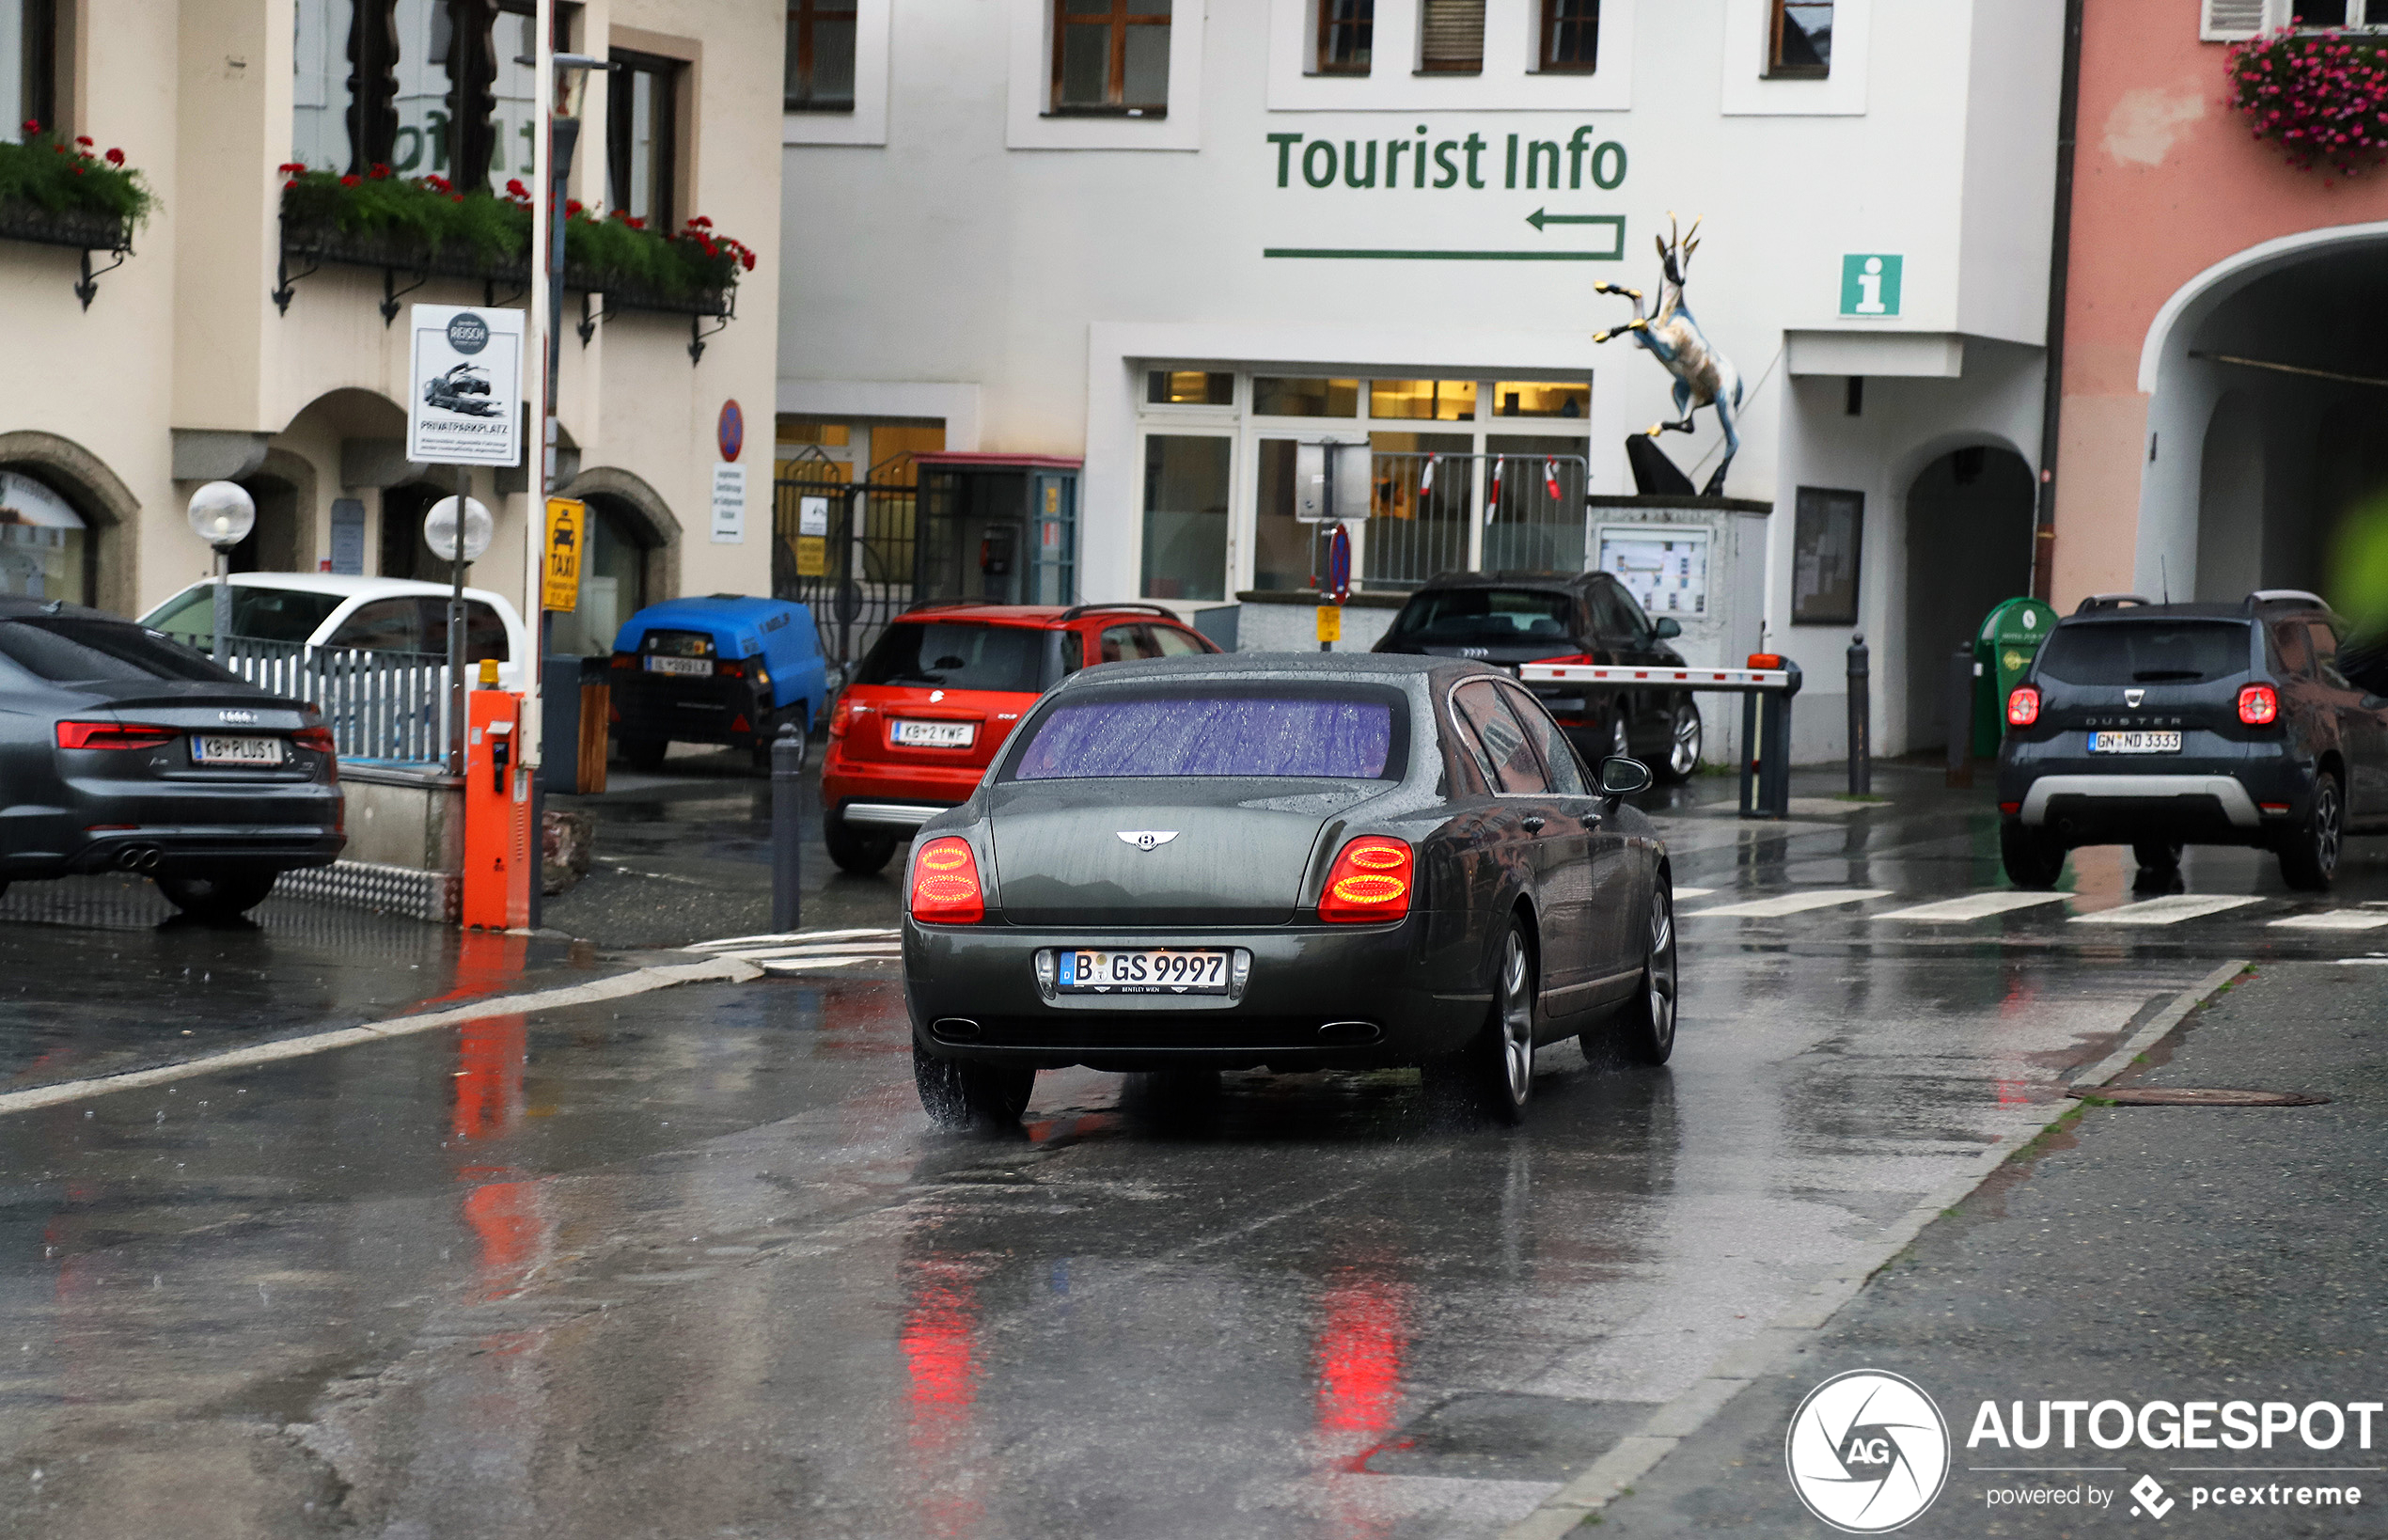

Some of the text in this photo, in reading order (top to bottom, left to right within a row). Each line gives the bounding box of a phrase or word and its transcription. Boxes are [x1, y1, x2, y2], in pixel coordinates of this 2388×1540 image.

[1265, 123, 1627, 190] Tourist Info
[450, 326, 485, 340] REISCH
[551, 554, 575, 577] TAXI
[2085, 717, 2182, 726] DUSTER
[905, 726, 920, 739] KB
[2097, 733, 2179, 748] GN ND 3333
[205, 738, 223, 757] KB
[1076, 955, 1092, 981] B
[1112, 954, 1147, 982] GS
[1154, 955, 1223, 982] 9997
